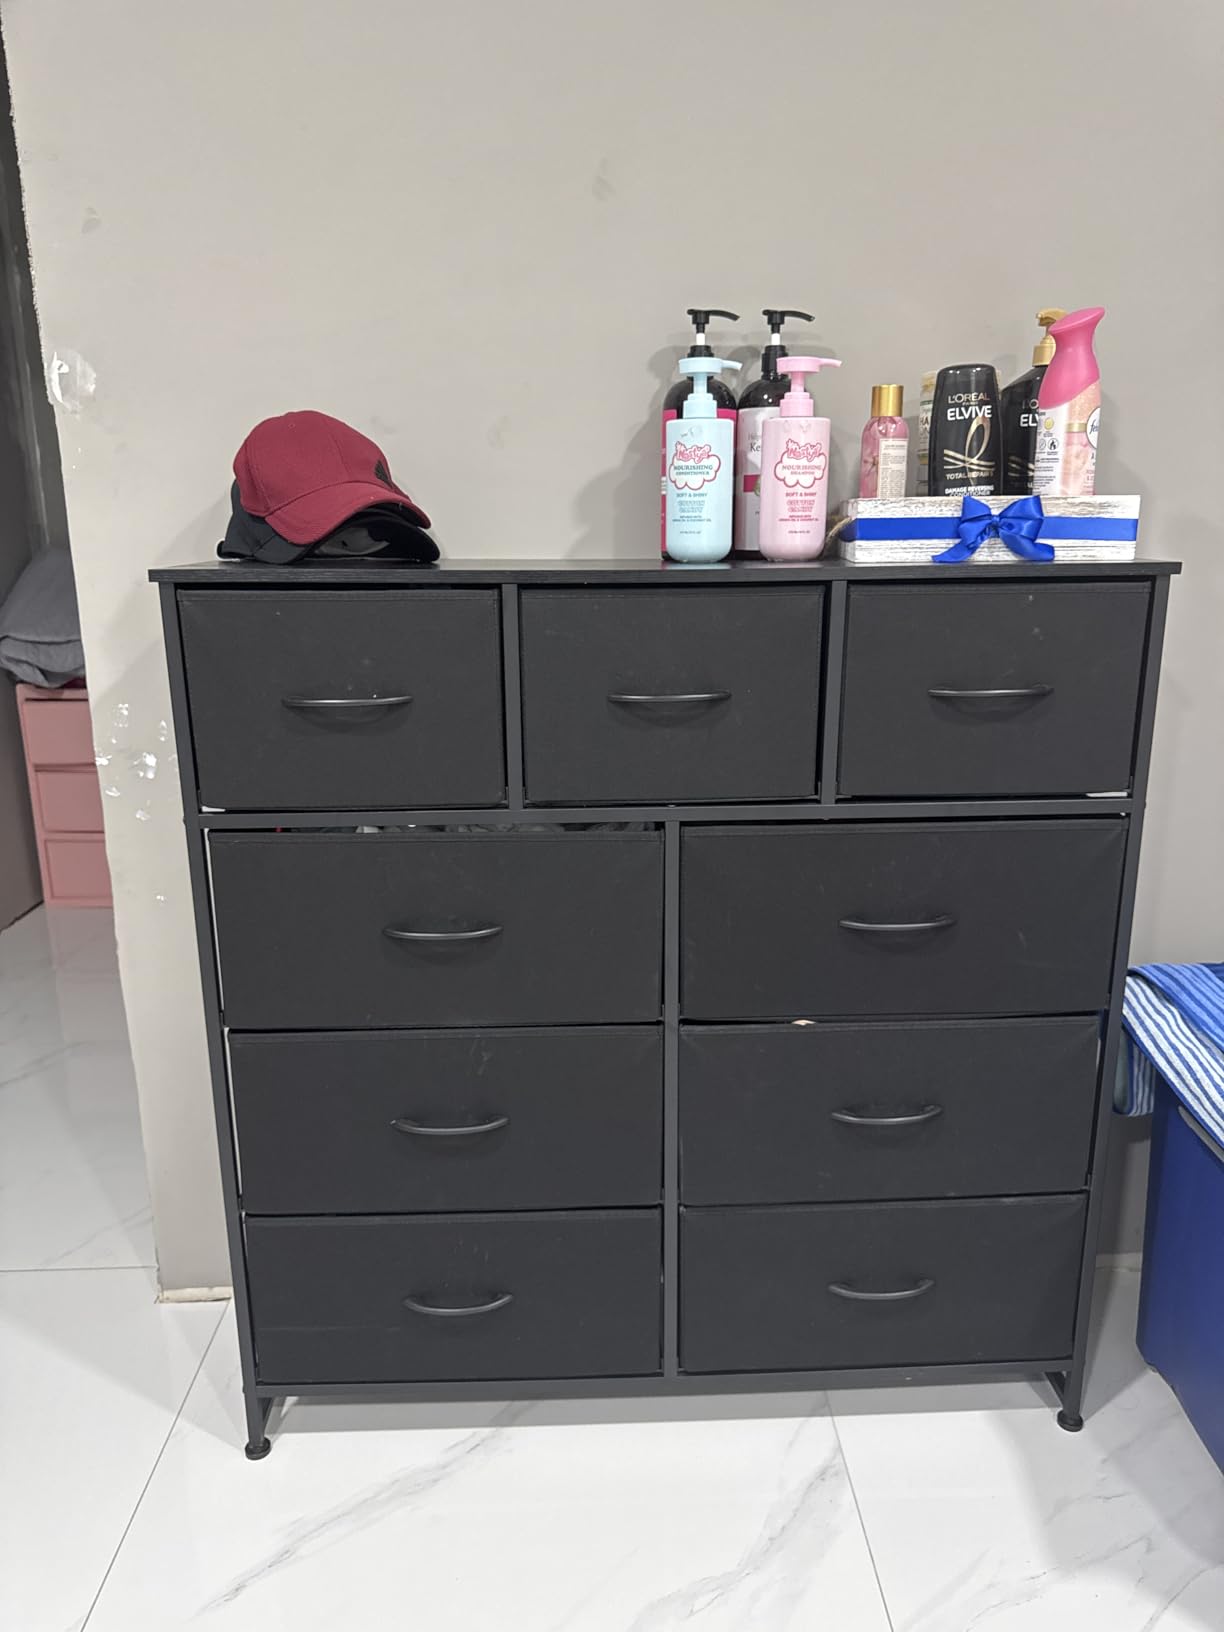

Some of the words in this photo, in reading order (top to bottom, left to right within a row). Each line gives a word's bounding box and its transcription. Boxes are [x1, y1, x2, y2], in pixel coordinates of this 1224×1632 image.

[946, 405, 993, 421] ELVIVE
[946, 471, 968, 480] TOTAL
[944, 486, 967, 495] DAMAGE
